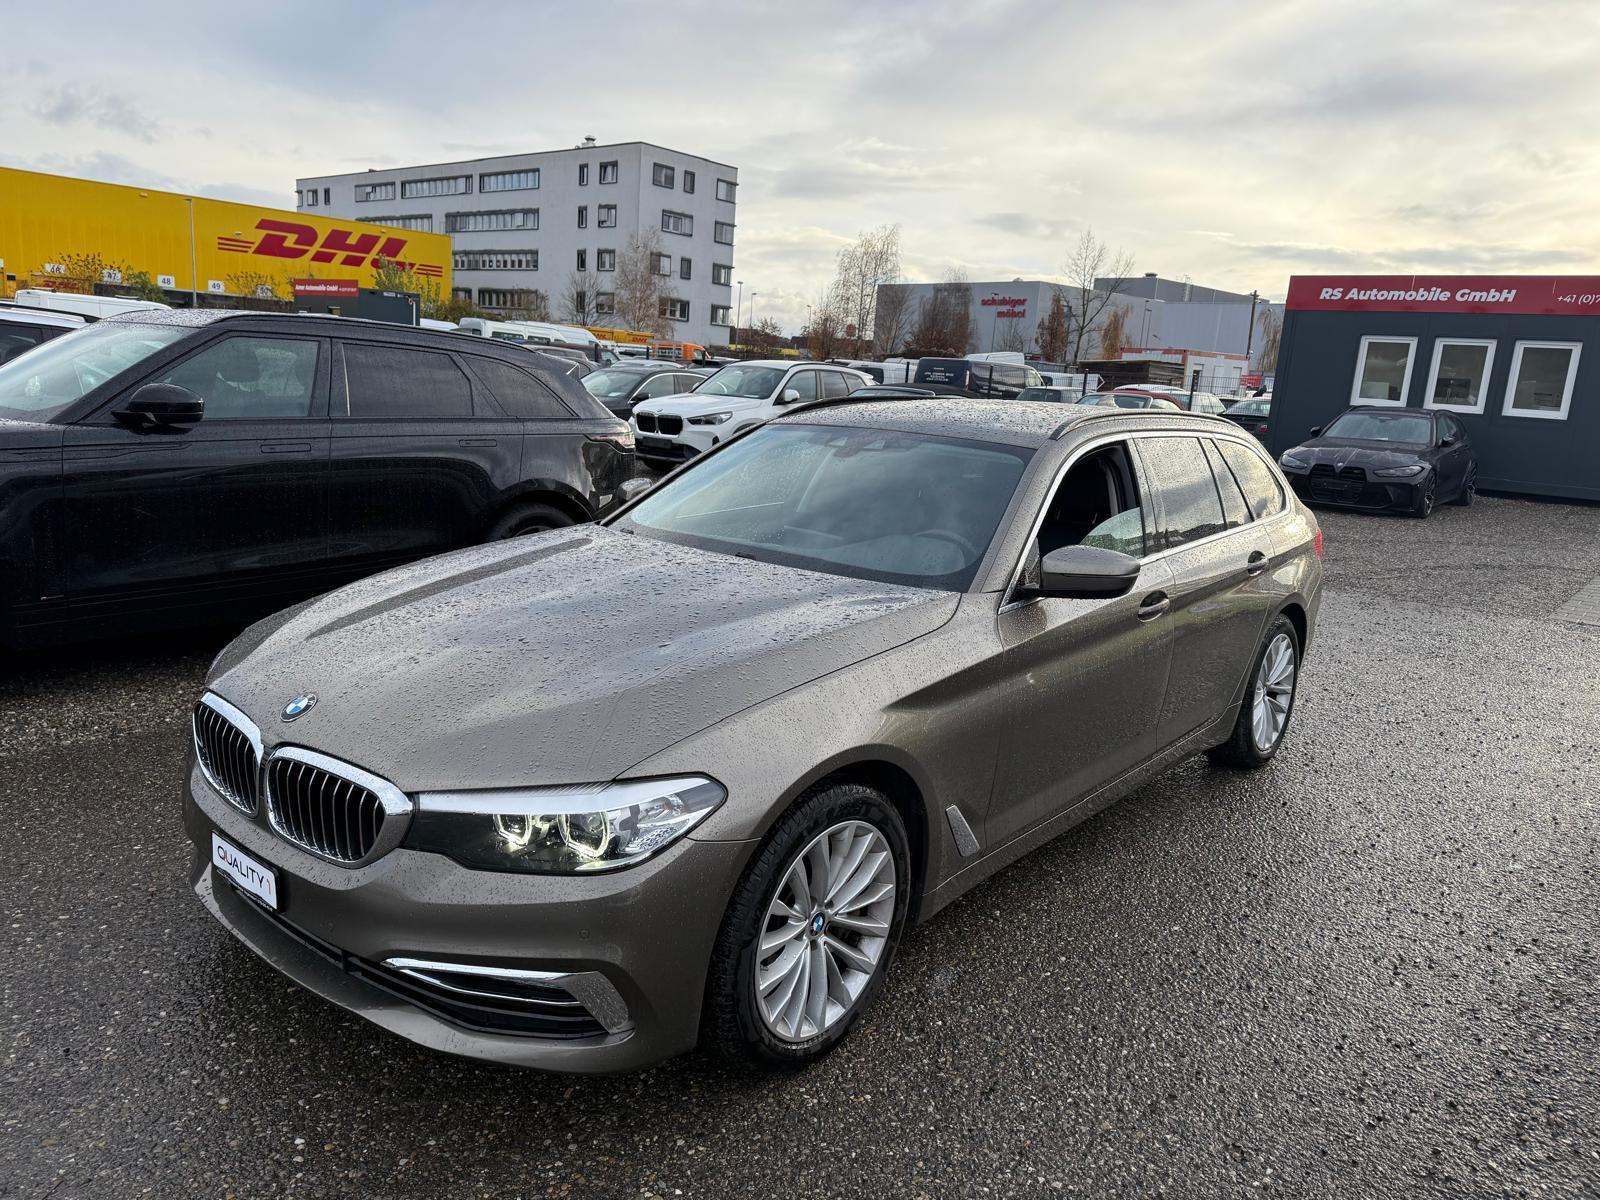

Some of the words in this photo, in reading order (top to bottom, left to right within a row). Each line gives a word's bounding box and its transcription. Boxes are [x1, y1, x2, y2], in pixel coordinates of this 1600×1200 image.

[252, 219, 416, 272] DHL
[161, 277, 172, 286] 48
[211, 282, 221, 290] 49
[1319, 287, 1343, 301] RS
[1345, 287, 1451, 302] Automobile
[1454, 288, 1517, 303] GmbH
[1557, 294, 1577, 303] +41
[217, 845, 265, 888] QUALITY
